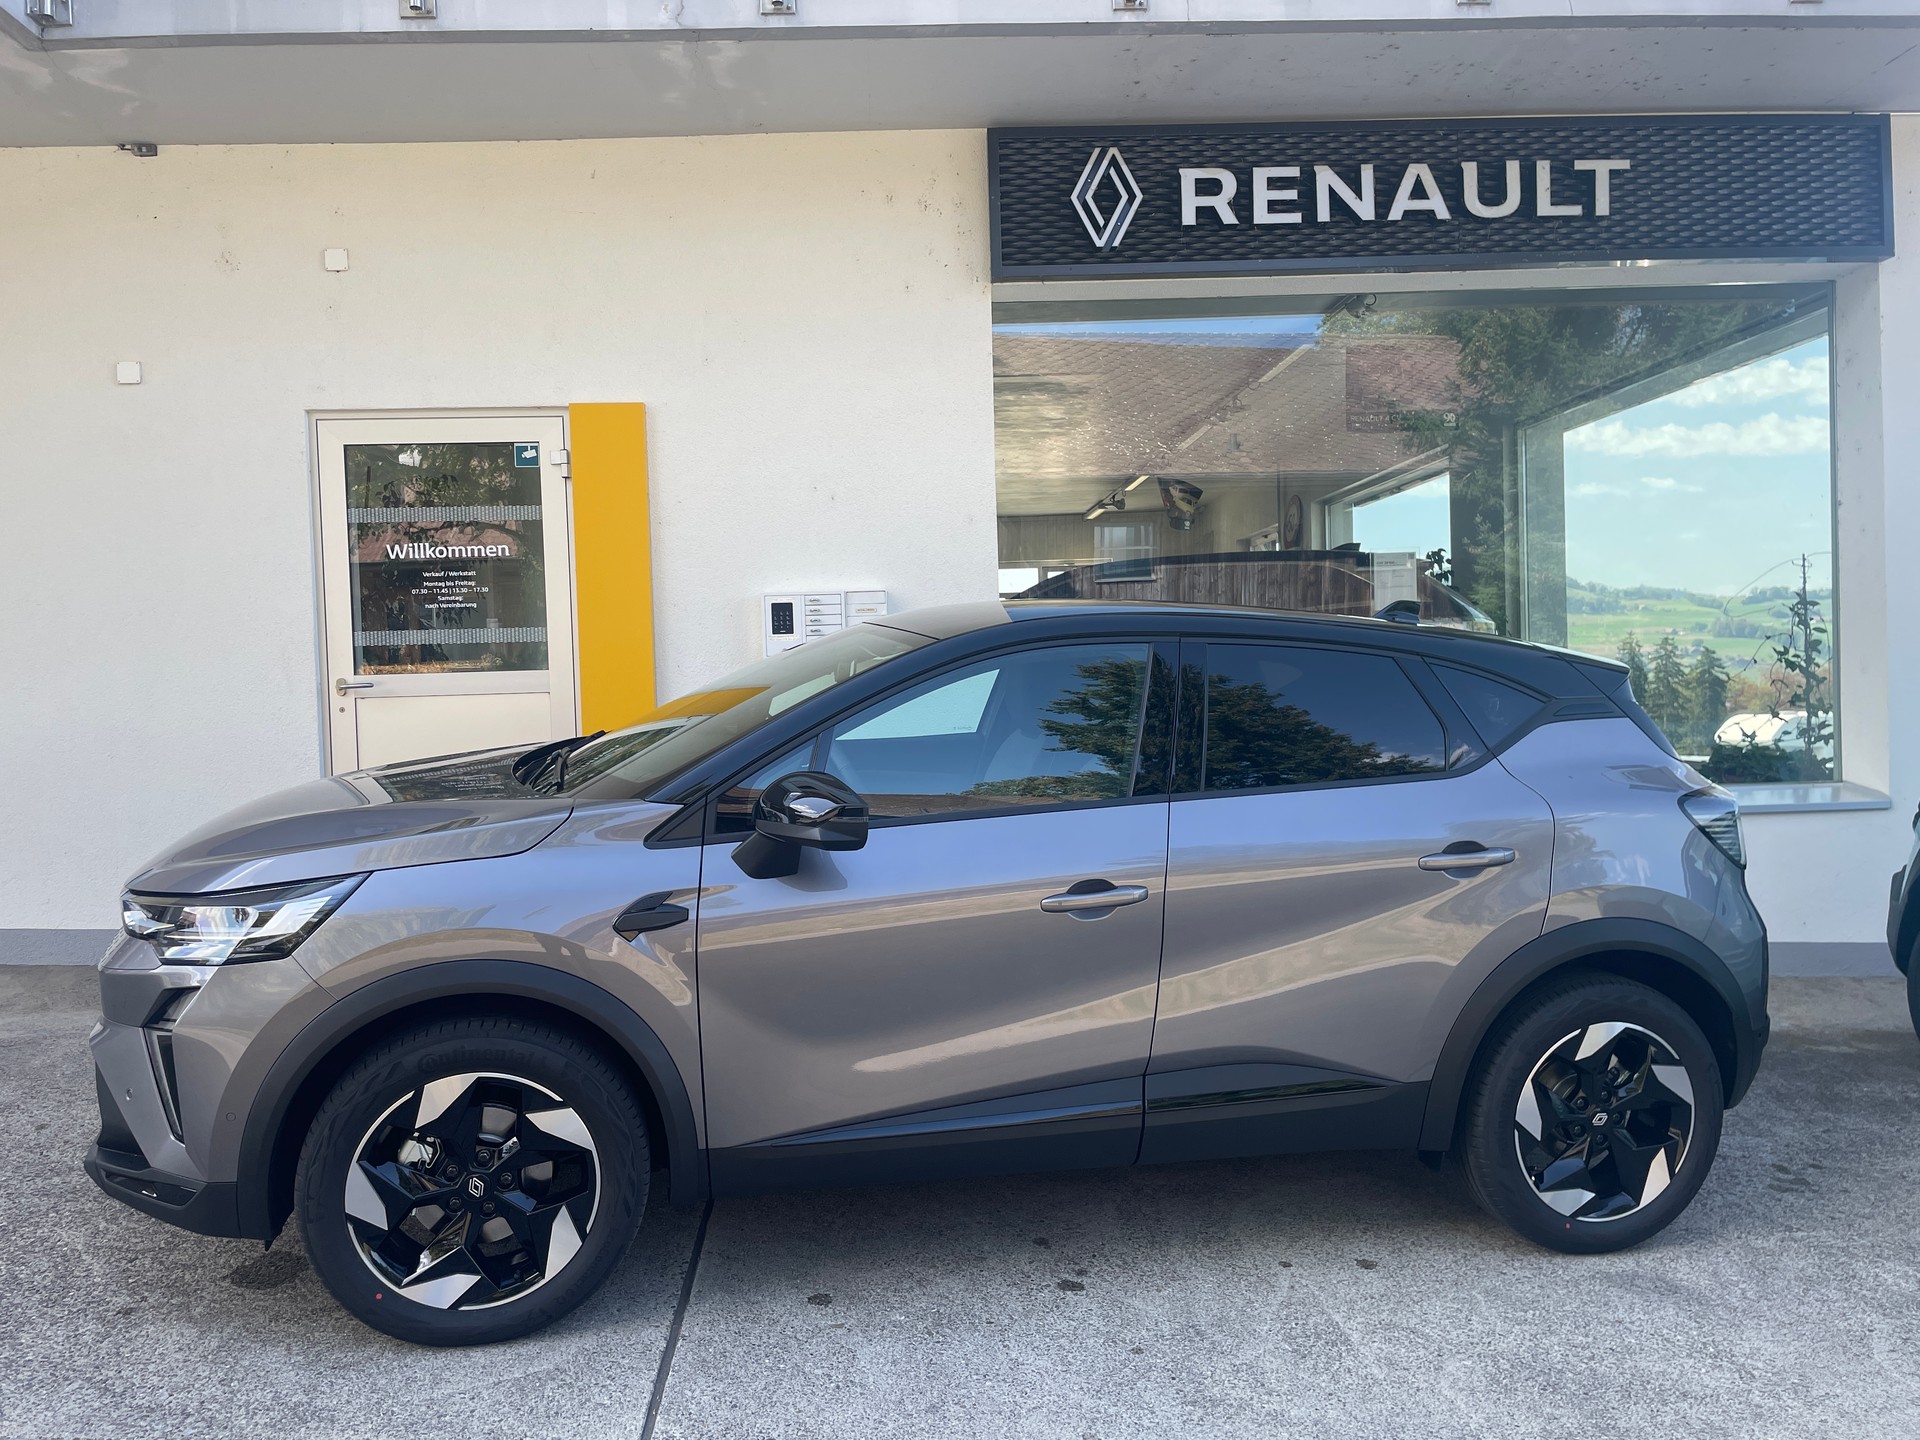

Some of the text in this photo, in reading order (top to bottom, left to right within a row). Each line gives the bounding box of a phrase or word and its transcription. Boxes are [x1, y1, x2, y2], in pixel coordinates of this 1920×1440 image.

[1178, 158, 1632, 227] RENAULT
[386, 543, 510, 559] Willkommen
[418, 1045, 536, 1074] Continental
